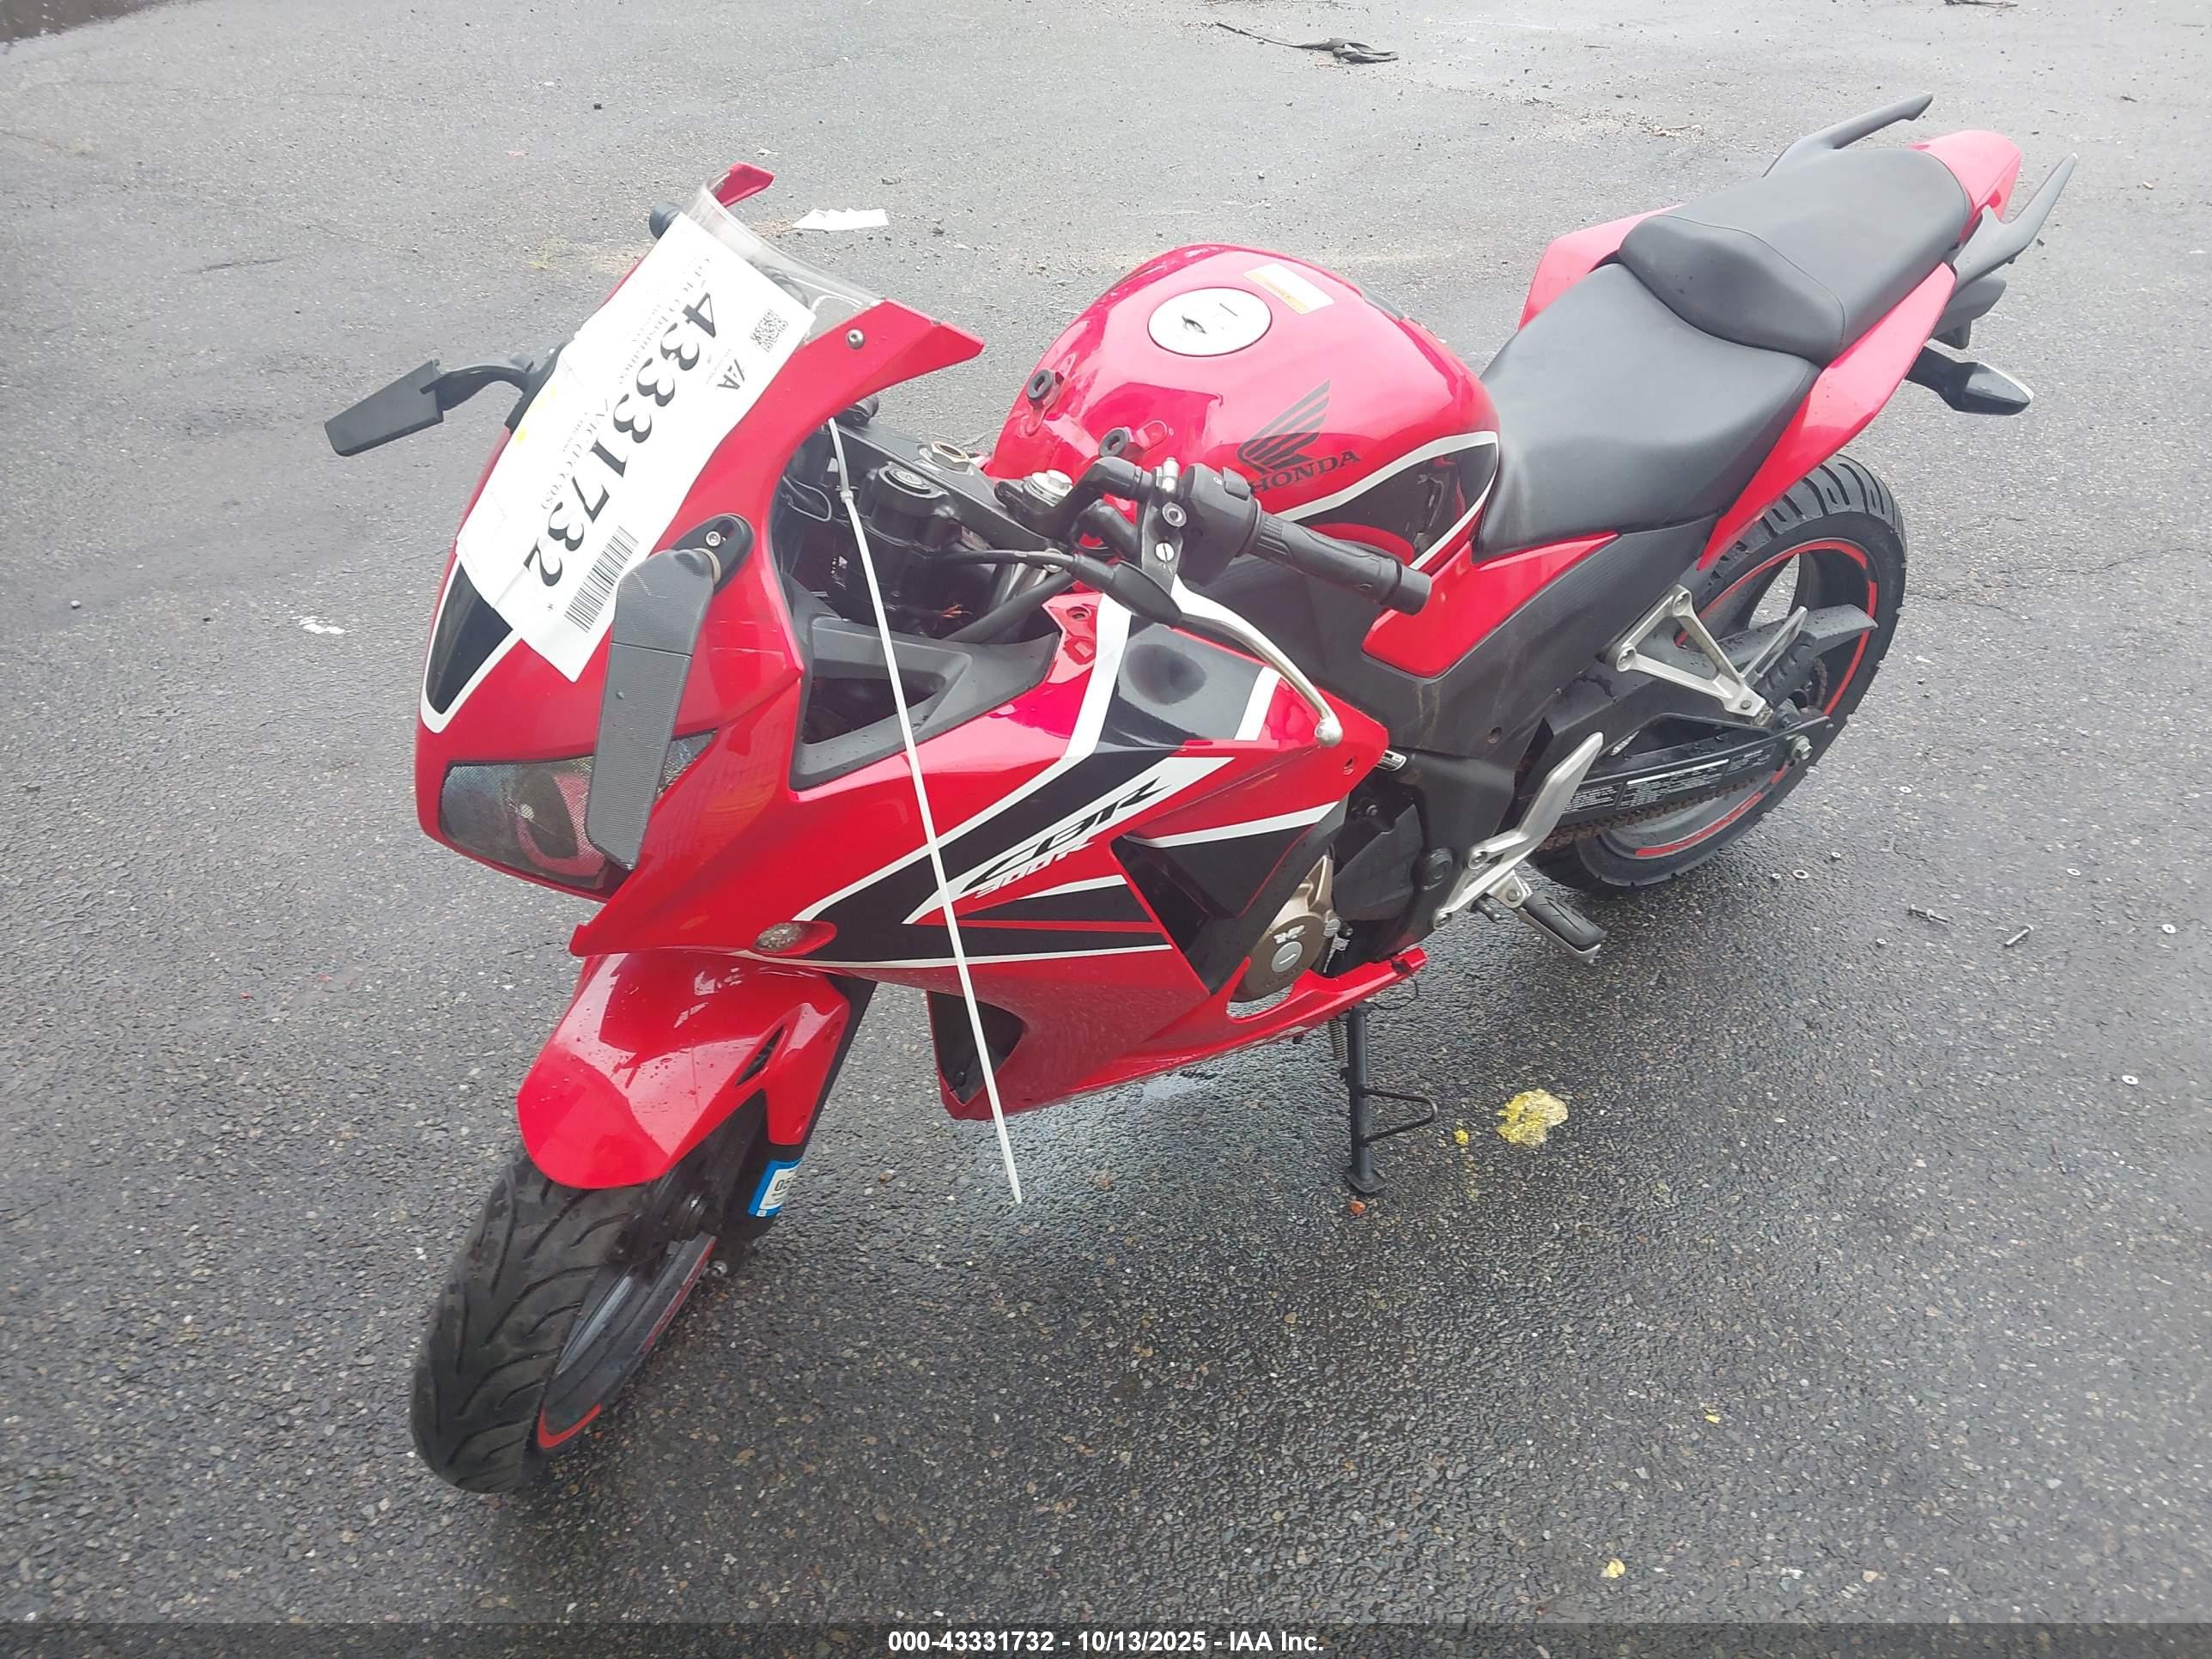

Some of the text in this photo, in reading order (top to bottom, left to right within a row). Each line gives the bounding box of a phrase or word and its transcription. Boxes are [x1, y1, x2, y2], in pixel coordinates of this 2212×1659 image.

[523, 294, 716, 586] 43331732
[1250, 449, 1361, 495] HONDA
[960, 775, 1172, 894] CBR
